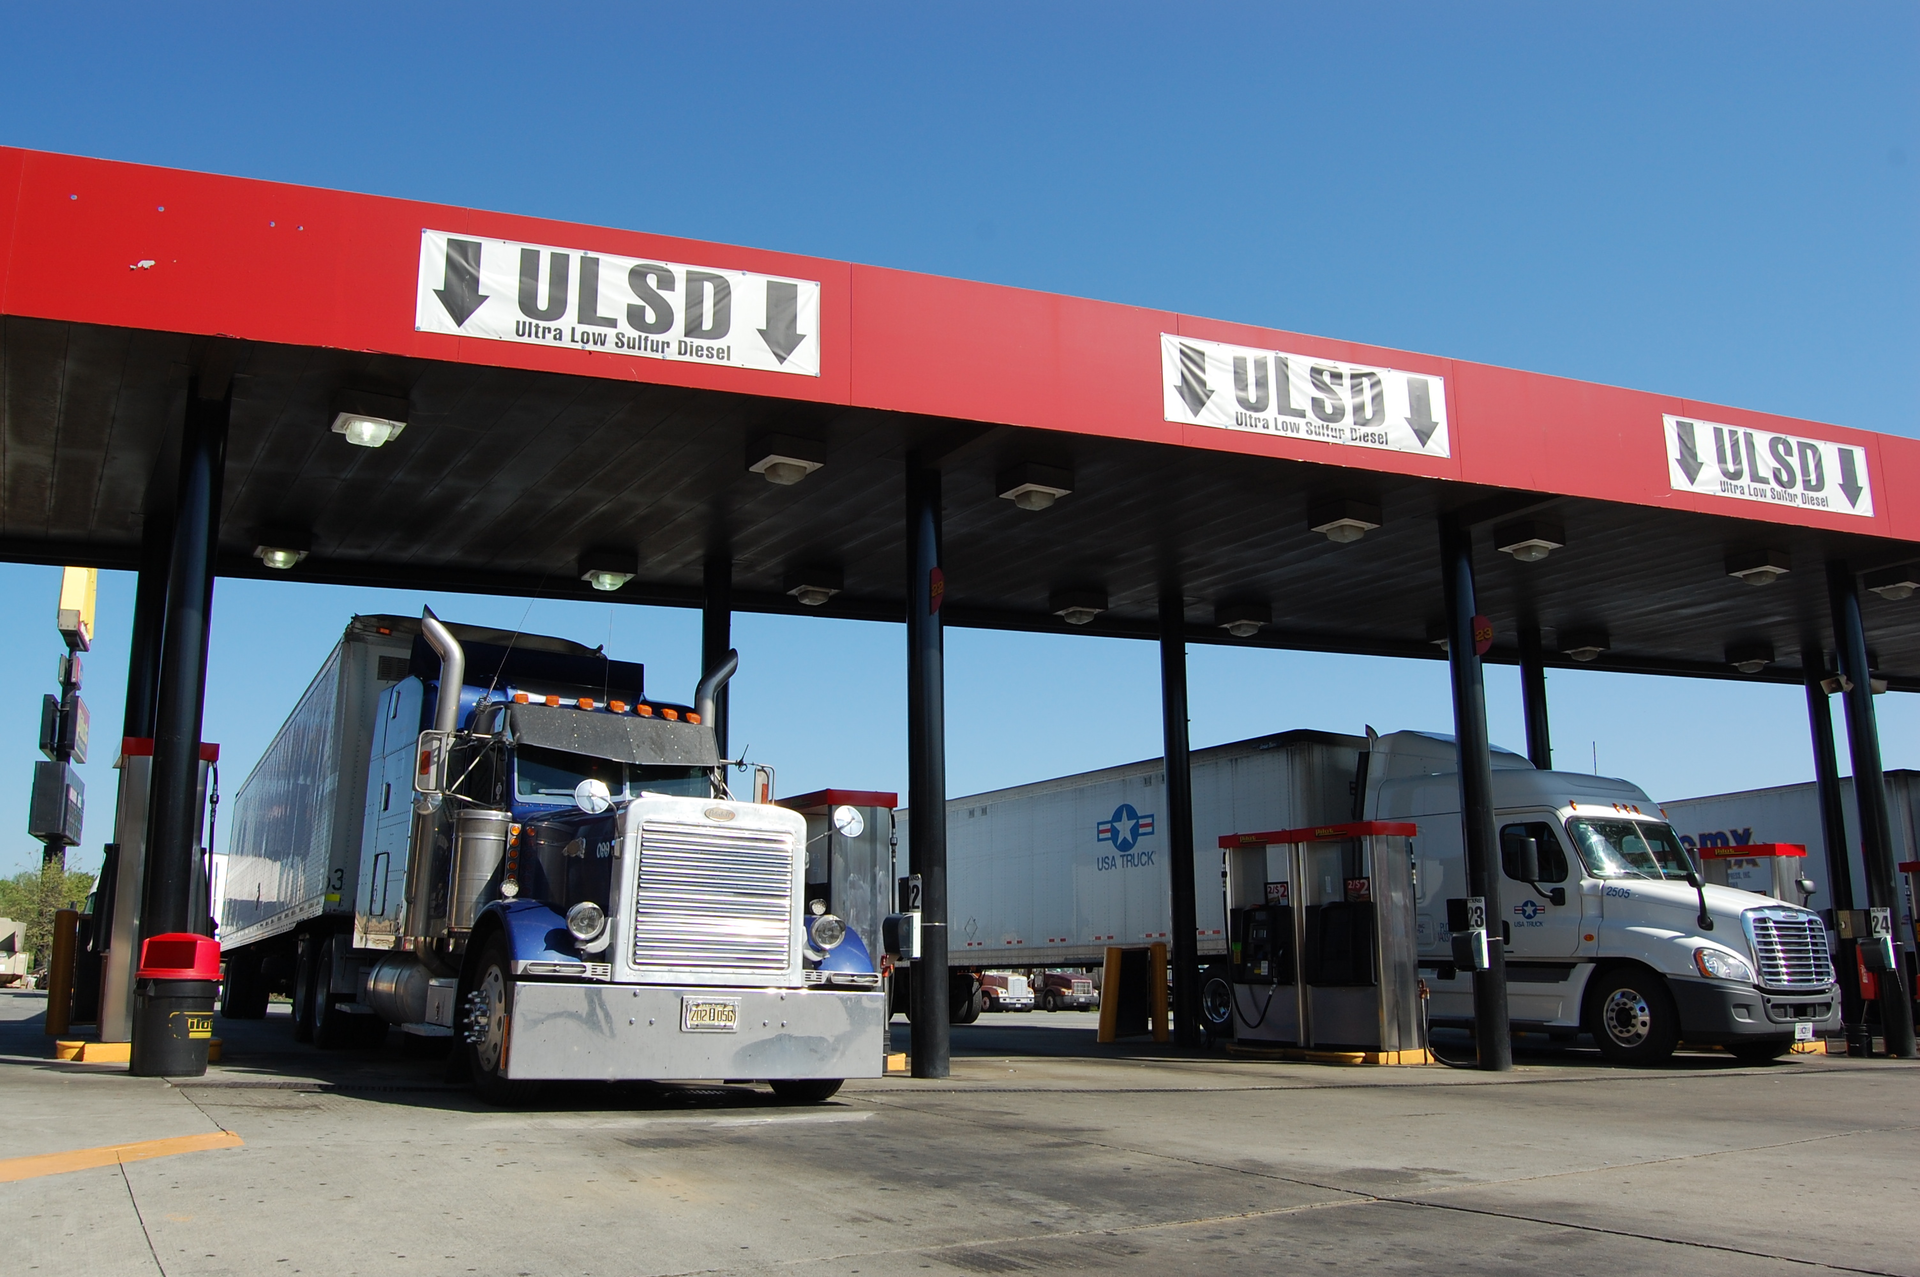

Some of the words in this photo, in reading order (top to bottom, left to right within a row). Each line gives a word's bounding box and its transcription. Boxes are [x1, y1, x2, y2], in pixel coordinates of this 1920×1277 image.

[518, 247, 732, 340] ULSD
[515, 320, 563, 342] Ultra
[570, 327, 607, 347] Low
[614, 332, 671, 355] Sulfur
[677, 340, 731, 361] Diesel
[1233, 355, 1386, 427] ULSD
[1235, 411, 1270, 430] Ultra
[1274, 417, 1300, 434] Low
[1305, 421, 1345, 440] Sulfur
[1350, 427, 1388, 445] Diesel
[1713, 426, 1826, 492] ULSD
[1719, 480, 1745, 495] Ultra
[1748, 483, 1767, 498] Low
[1770, 487, 1798, 503] Sulfur
[1801, 493, 1829, 507] Diesel
[1476, 628, 1492, 642] 23
[1097, 856, 1117, 871] USA
[1120, 851, 1155, 869] TRUCK
[909, 884, 920, 910] 2
[1606, 886, 1631, 899] 2505
[1468, 906, 1484, 928] 23
[1872, 915, 1890, 934] 24
